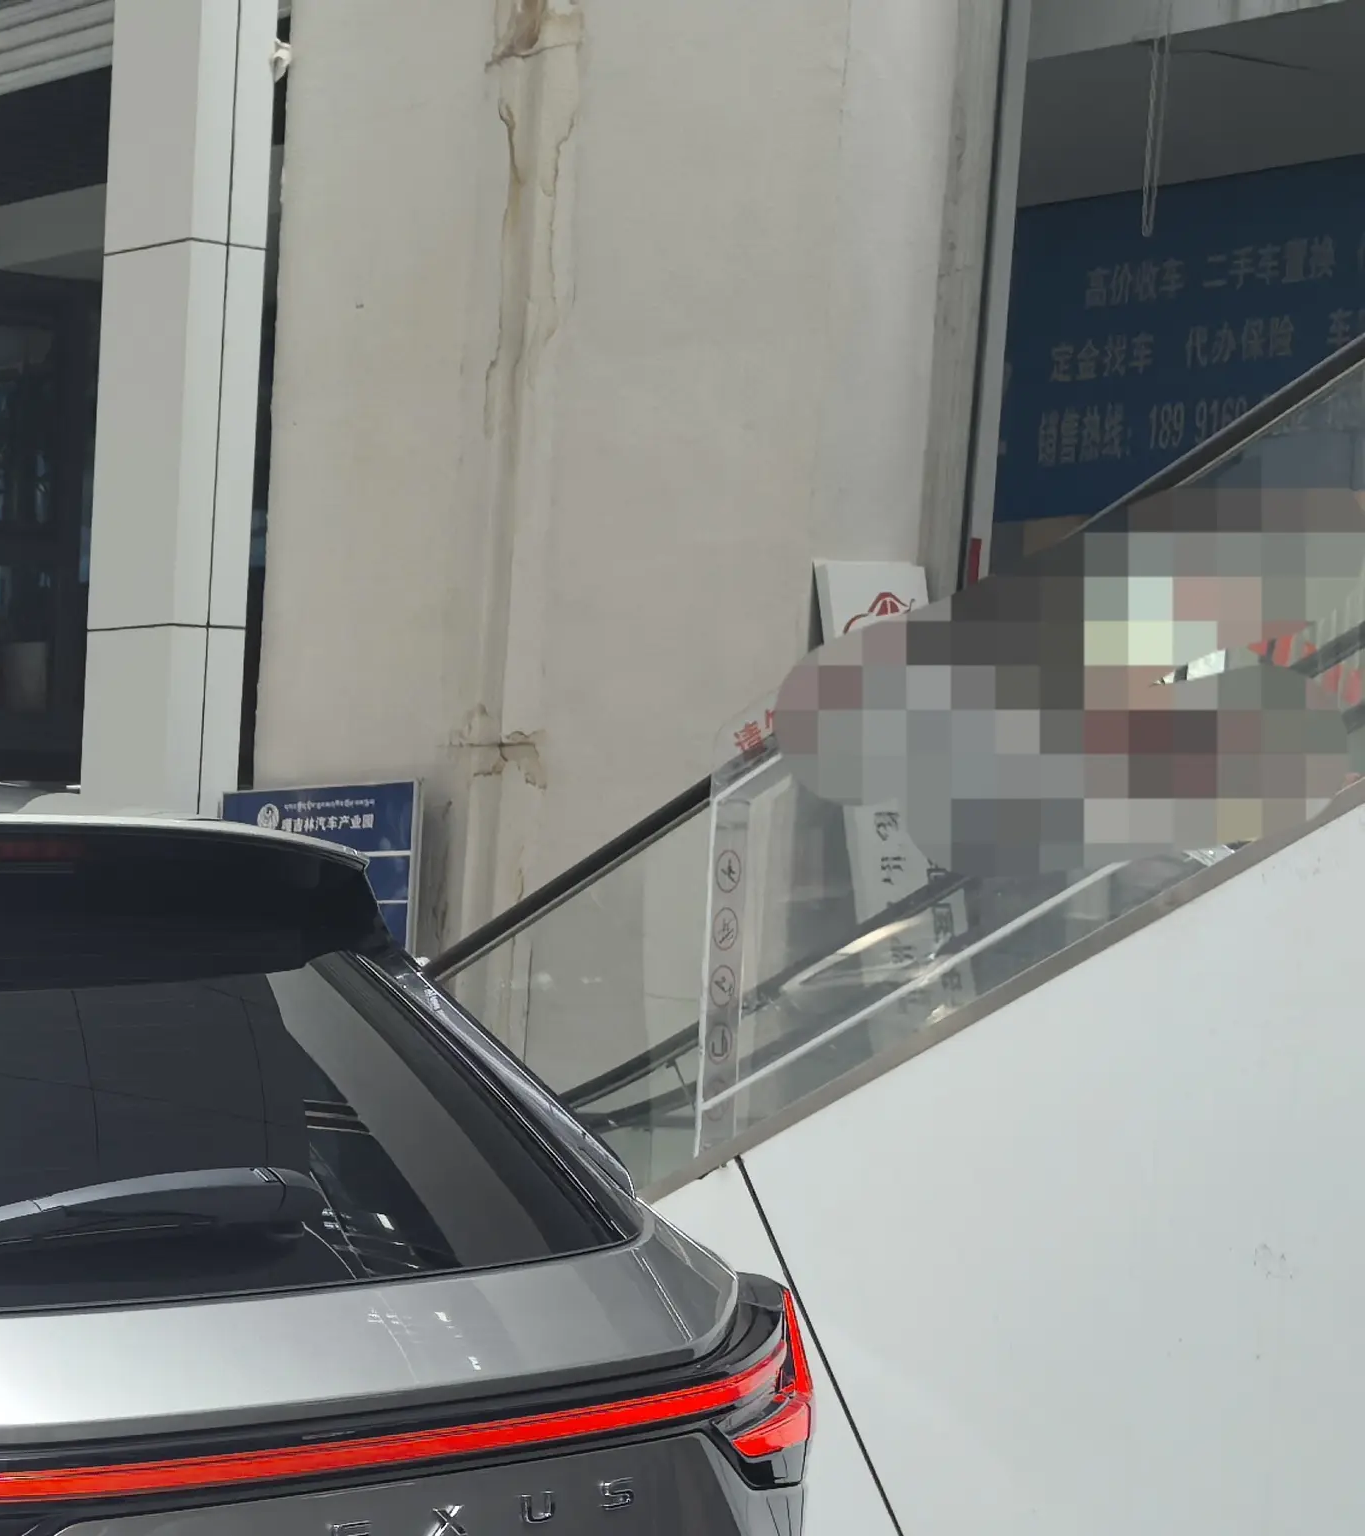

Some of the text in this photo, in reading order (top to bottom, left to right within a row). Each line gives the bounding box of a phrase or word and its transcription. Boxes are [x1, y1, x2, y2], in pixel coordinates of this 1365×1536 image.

[1086, 259, 1184, 308] 高价收车
[1204, 236, 1336, 290] 二手车置换
[1051, 332, 1155, 382] 定金找车
[1186, 316, 1295, 367] 代办保险
